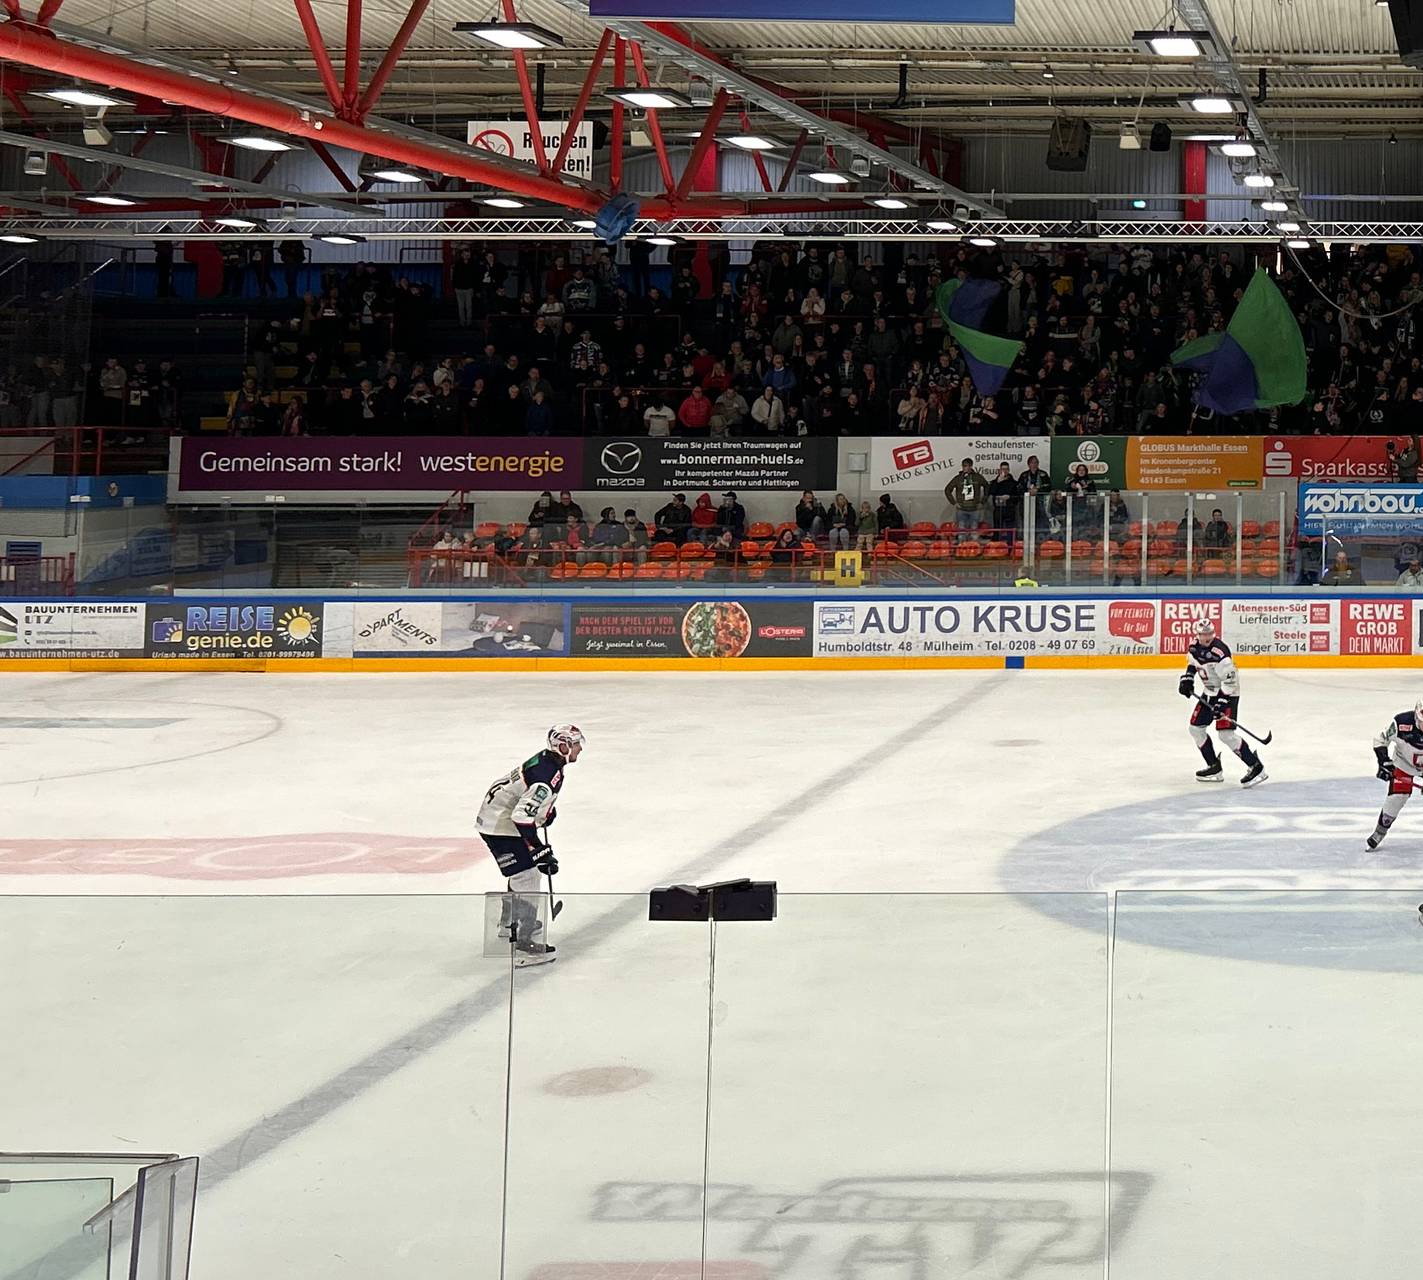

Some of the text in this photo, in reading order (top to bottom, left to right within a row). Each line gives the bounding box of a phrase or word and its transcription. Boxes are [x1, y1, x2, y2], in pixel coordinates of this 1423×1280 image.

[743, 442, 788, 450] Traumwagen
[975, 440, 1038, 449] Schaufenster-
[1140, 444, 1248, 452] GLOBUS Markthalle Essen
[660, 453, 804, 465] www.bonnermann-huels.de
[975, 453, 1023, 462] gestaltung
[200, 451, 565, 477] Gemeinsam stark! westenergie
[687, 470, 733, 479] kompetenter
[881, 458, 955, 487] DEKO & STYLE
[975, 467, 1000, 476] Visua
[763, 480, 799, 488] Hattingen
[1165, 477, 1187, 485] Essen
[841, 559, 855, 577] H
[1110, 608, 1154, 618] VOM FEINSTEN
[1164, 603, 1220, 620] REWE
[1231, 603, 1307, 613] Altenessen-Süd
[1350, 603, 1404, 620] REWE
[25, 615, 54, 624] UTZ
[187, 606, 275, 631] REISE
[860, 605, 1096, 633] AUTO KRUSE
[1302, 615, 1308, 624] 3
[1124, 623, 1134, 633] für
[1356, 621, 1397, 636] GROB
[1274, 631, 1307, 640] Steele
[187, 632, 273, 651] genie.de
[819, 640, 1096, 652] Humboldtstr. 48 Mülheim Tel. 0208 49 07 69
[1164, 636, 1185, 653] DEIN
[1350, 637, 1404, 653] DEIN MARKT
[1132, 644, 1153, 654] Essen
[1237, 643, 1272, 655] Isinger
[1274, 643, 1291, 652] Tor
[1295, 643, 1306, 652] 14
